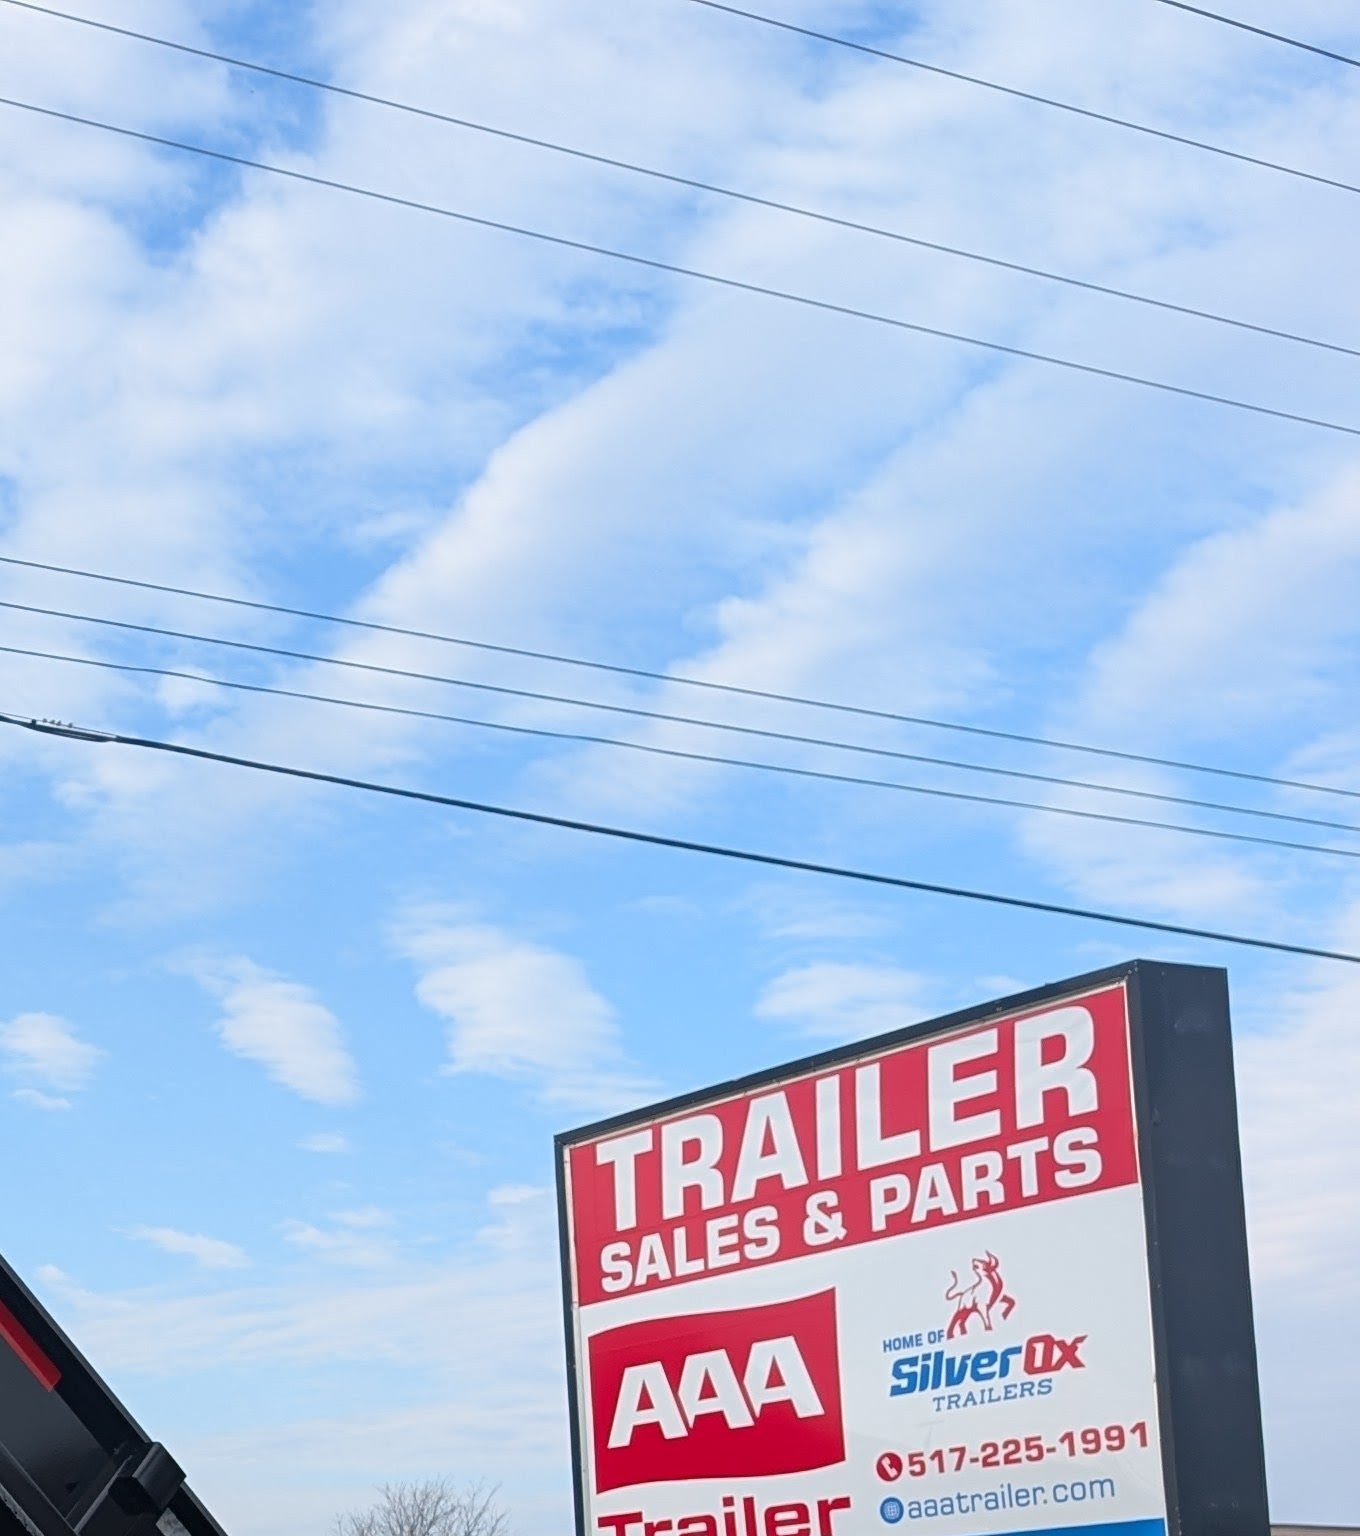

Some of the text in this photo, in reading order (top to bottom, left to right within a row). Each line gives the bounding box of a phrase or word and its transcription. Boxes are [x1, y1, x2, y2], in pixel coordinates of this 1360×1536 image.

[595, 1005, 1099, 1231] TRAILER
[600, 1127, 1103, 1293] SALES & PARTS
[883, 1330, 946, 1351] HOME OF
[608, 1336, 825, 1449] AAA
[932, 1378, 1053, 1412] TRAILERS
[907, 1421, 1149, 1477] 517-225-1991
[908, 1478, 1116, 1519] aaatrailer.com
